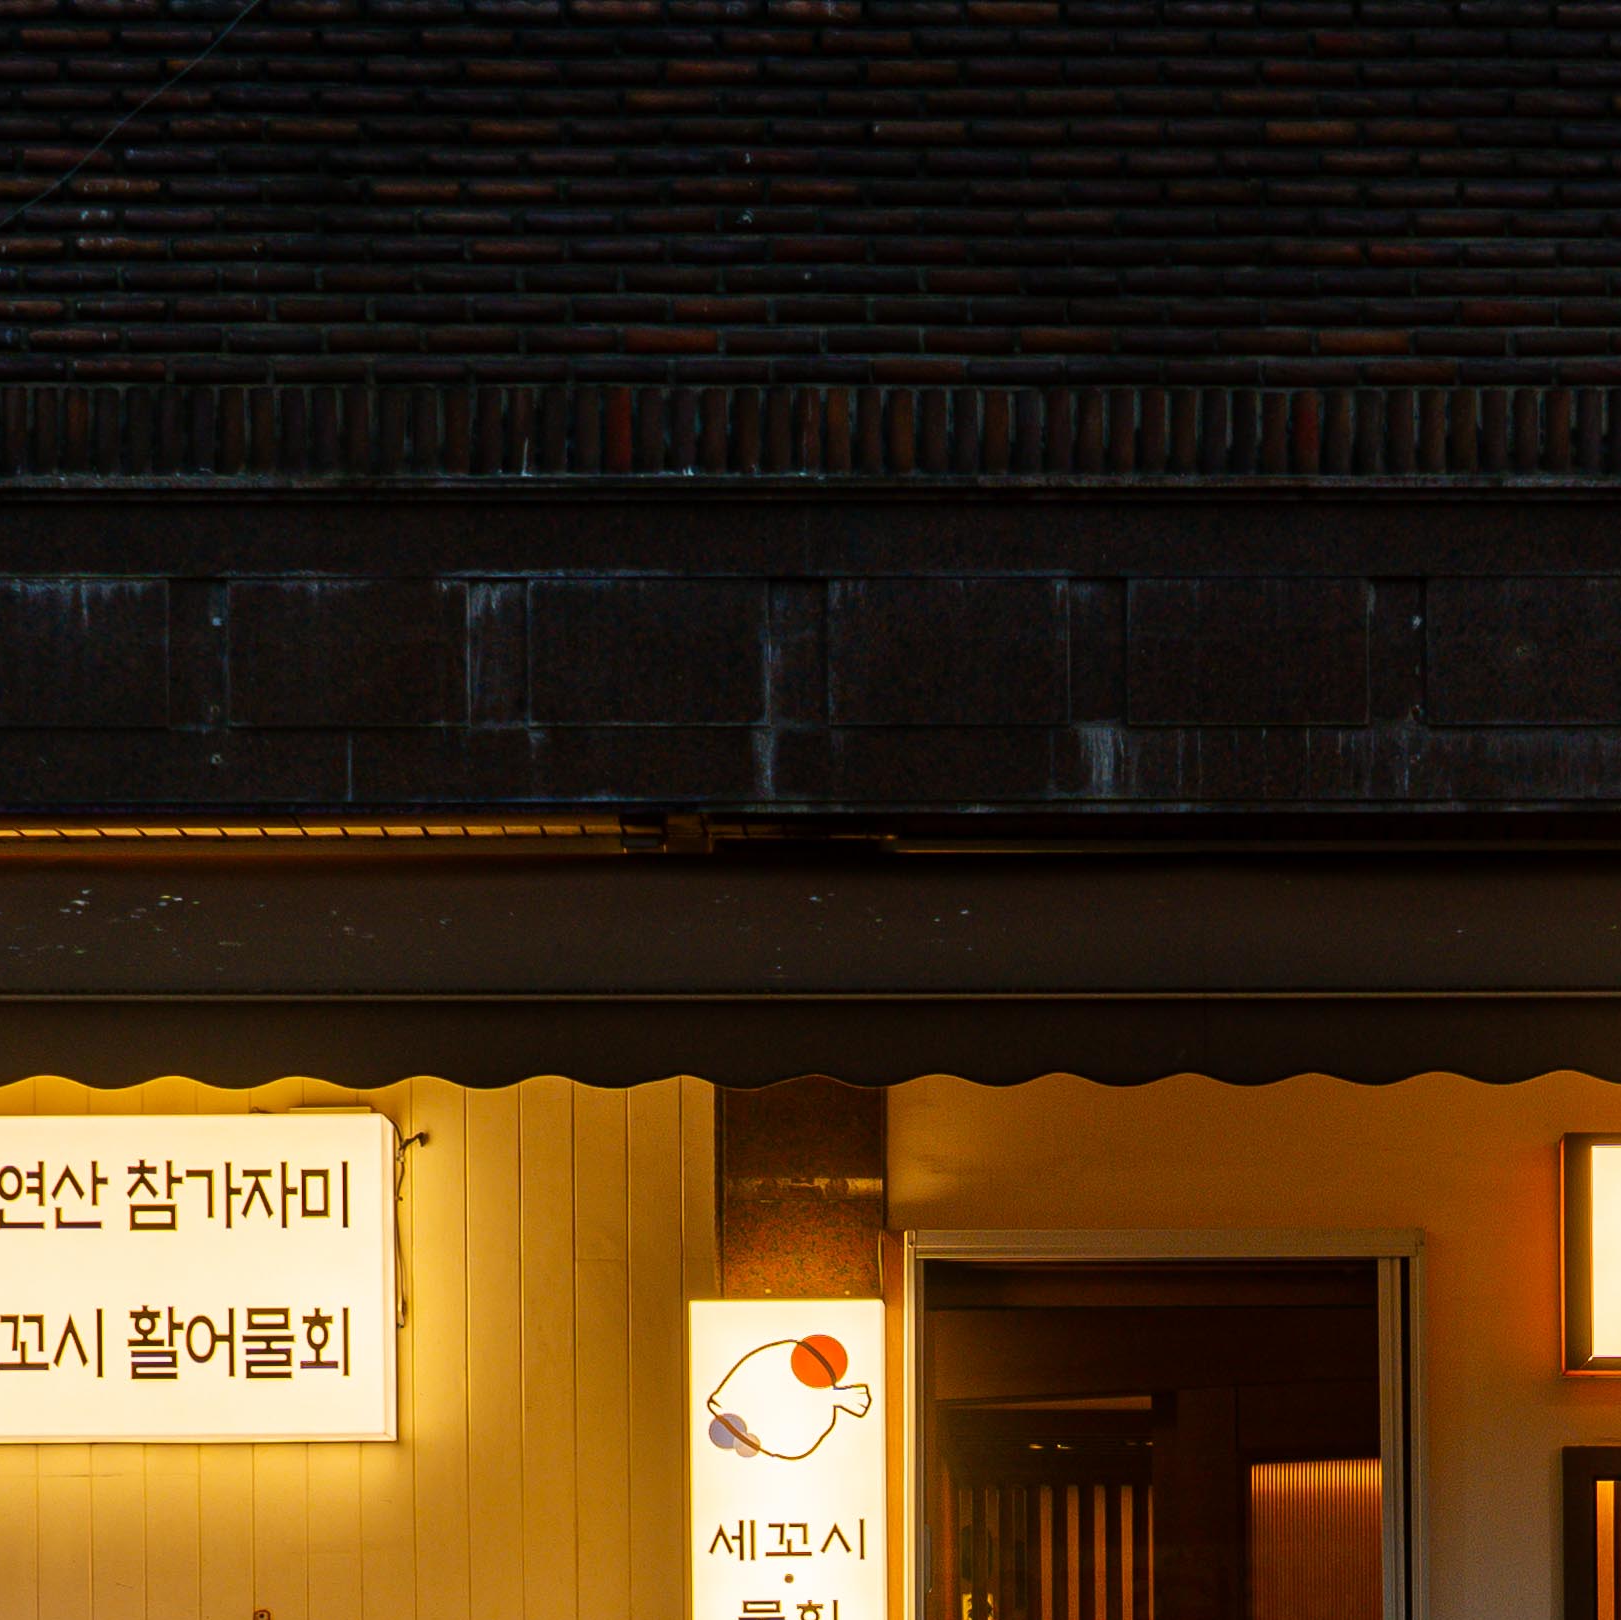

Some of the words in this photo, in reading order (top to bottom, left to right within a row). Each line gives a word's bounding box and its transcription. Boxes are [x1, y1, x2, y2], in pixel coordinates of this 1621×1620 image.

[126, 1159, 351, 1233] 참가자미
[127, 1305, 351, 1381] 활어물회
[709, 1518, 866, 1561] 세꼬시
